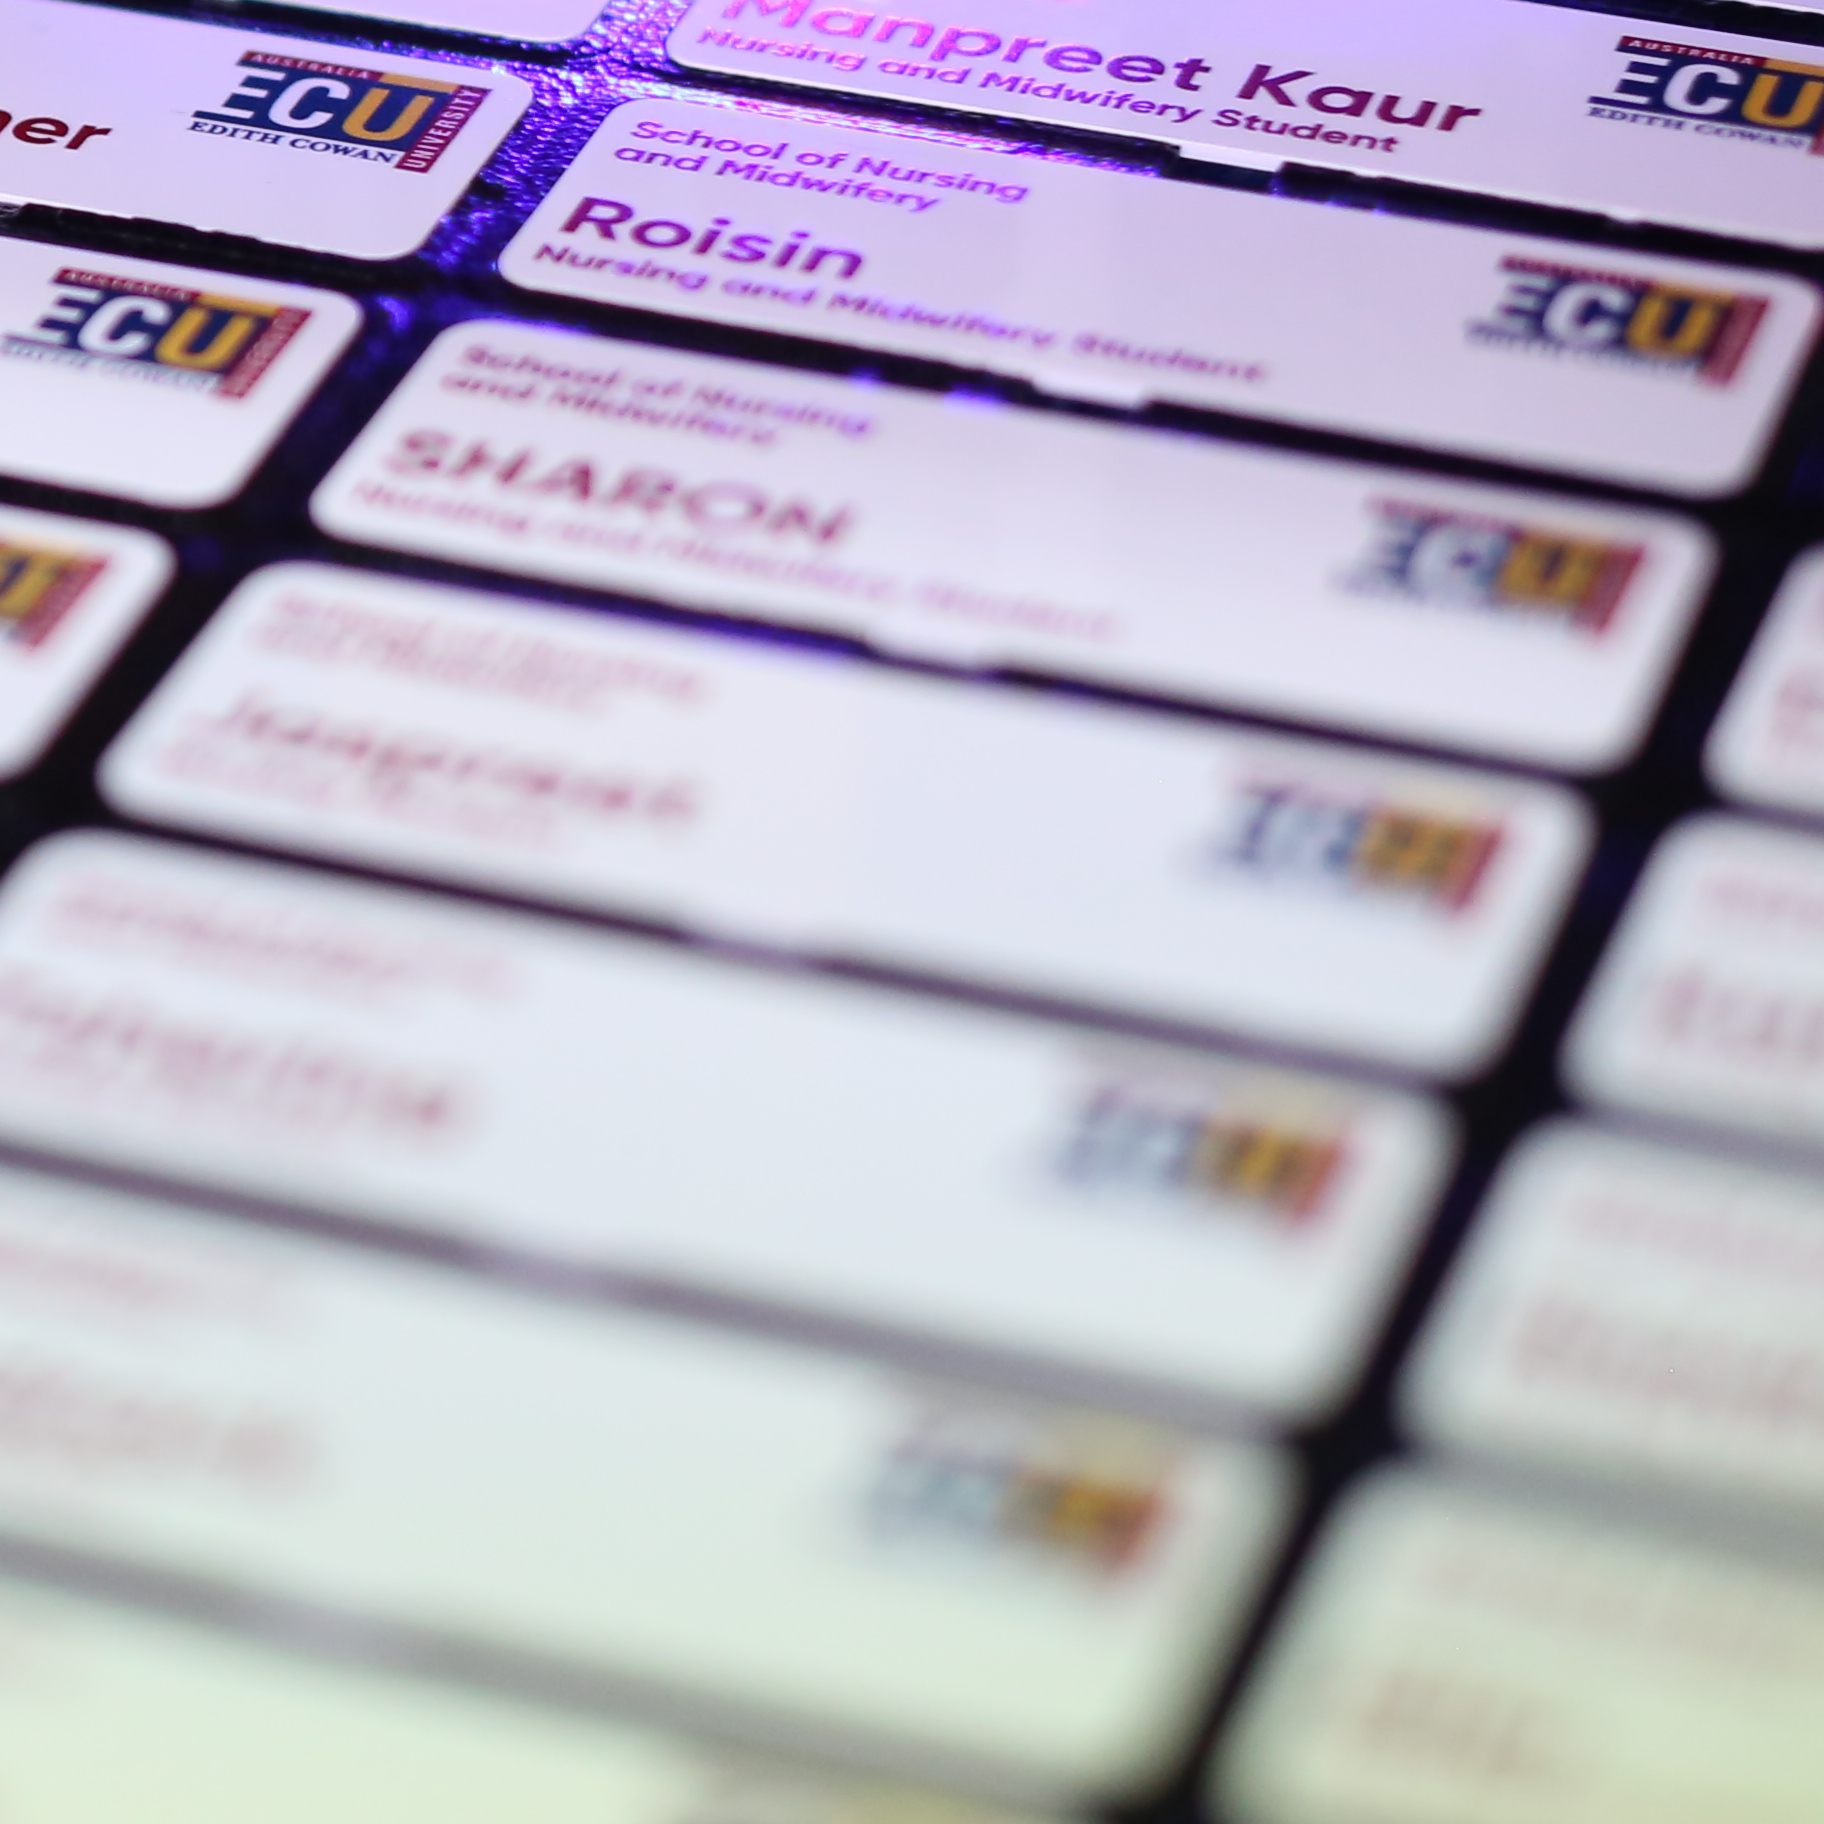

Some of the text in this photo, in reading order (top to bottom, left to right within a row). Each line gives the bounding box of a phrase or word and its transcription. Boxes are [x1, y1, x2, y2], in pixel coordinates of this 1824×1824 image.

[251, 52, 370, 79] AUSTRALIA
[1627, 38, 1756, 67] AUSTRALIA
[209, 65, 435, 143] ECU
[401, 85, 485, 171] UNIVERSITY
[695, 25, 1403, 156] Nursing and Midwifery Student
[1236, 63, 1484, 134] Kaur
[1585, 106, 1685, 132] EDITH
[186, 121, 398, 165] EDITH COWAN
[613, 141, 942, 214] and Midwifery
[628, 118, 1032, 206] School of Nursing
[533, 240, 710, 293] Nursing
[720, 272, 820, 309] and
[556, 194, 867, 282] Roisin
[26, 288, 252, 372] ECU
[382, 428, 860, 553] SHARON
